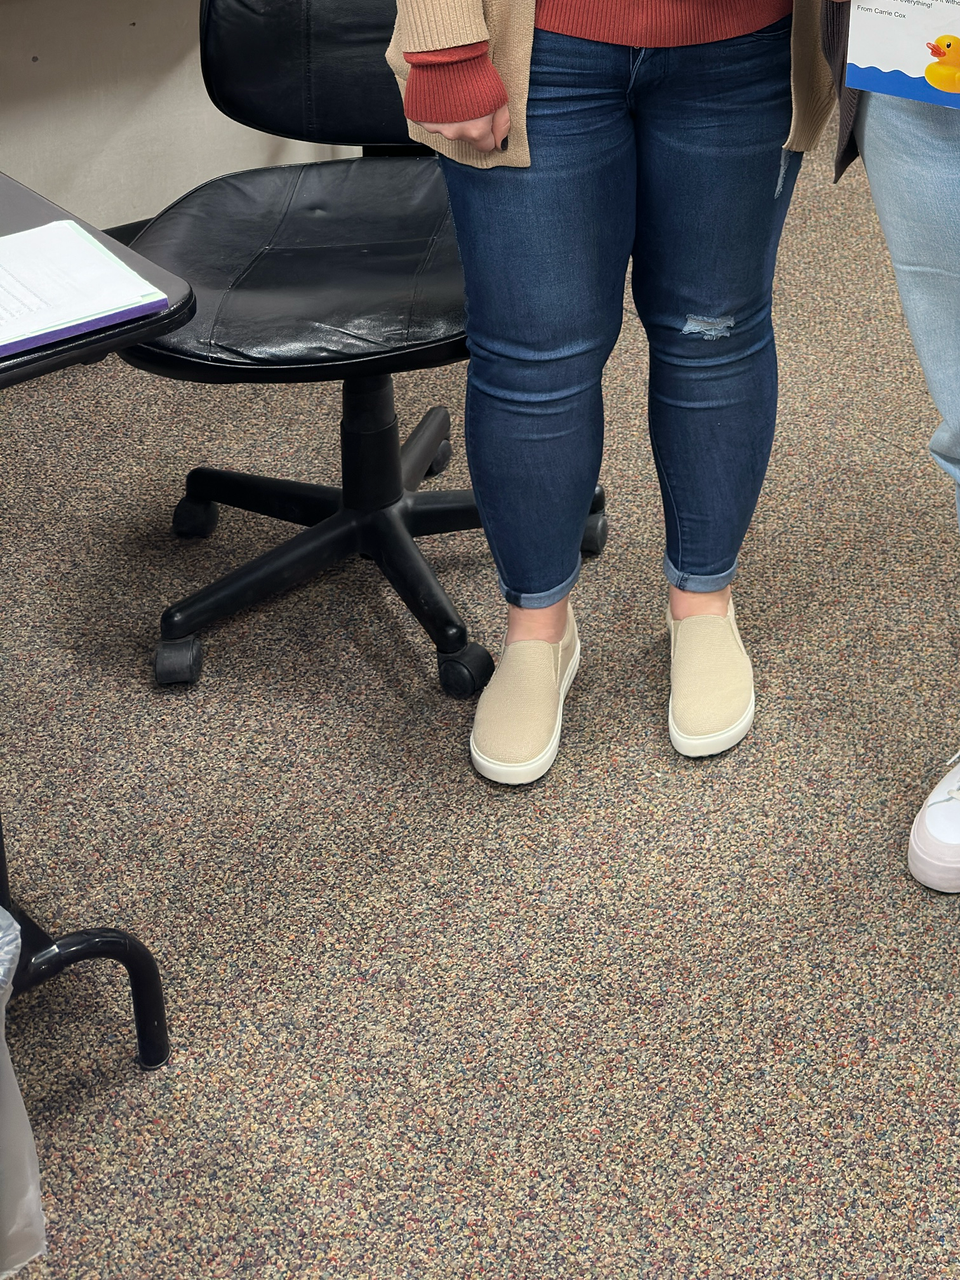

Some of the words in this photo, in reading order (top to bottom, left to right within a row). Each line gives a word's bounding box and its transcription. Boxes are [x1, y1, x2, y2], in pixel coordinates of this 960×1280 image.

[856, 4, 873, 13] From
[874, 7, 893, 17] Carrie
[894, 10, 907, 19] Cox
